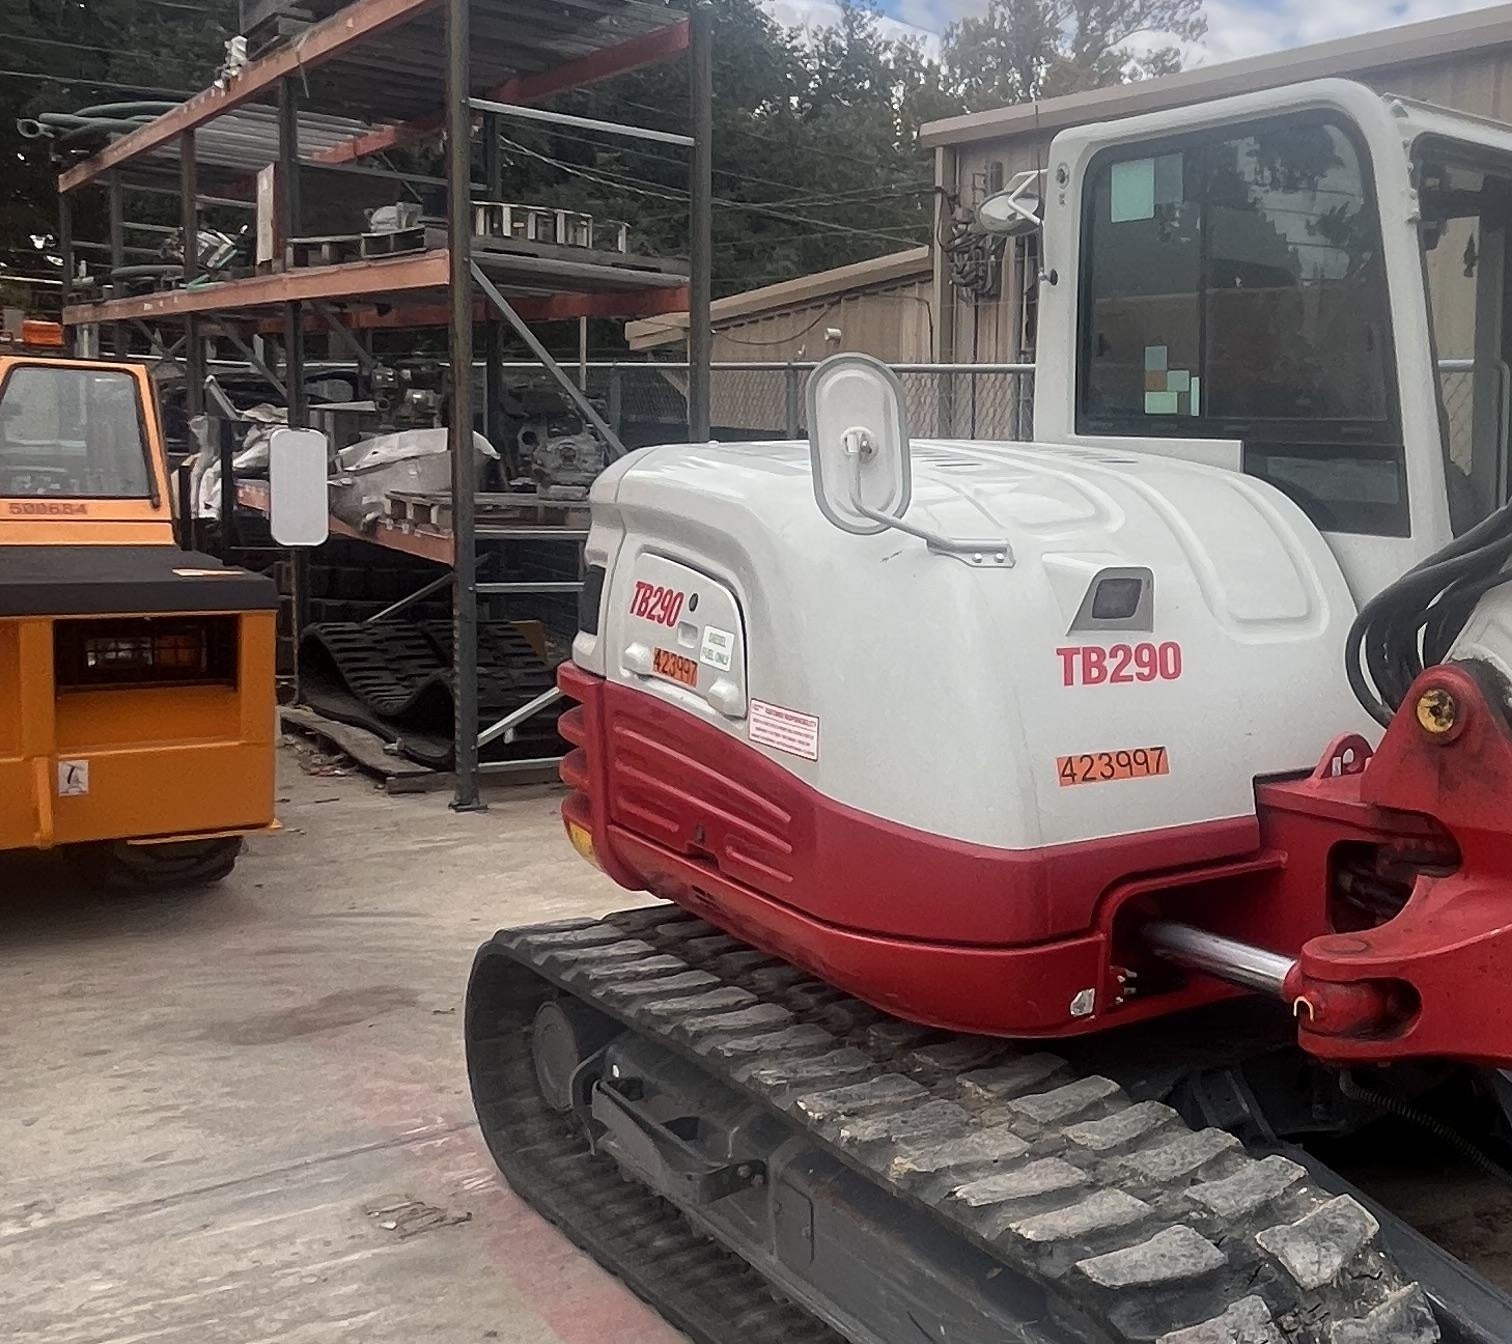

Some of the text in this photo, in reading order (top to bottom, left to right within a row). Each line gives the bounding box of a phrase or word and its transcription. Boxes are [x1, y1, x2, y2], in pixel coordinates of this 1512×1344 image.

[629, 581, 685, 628] TB290
[653, 648, 698, 687] 423997
[1056, 641, 1182, 686] TB290
[1060, 746, 1166, 783] 423997
